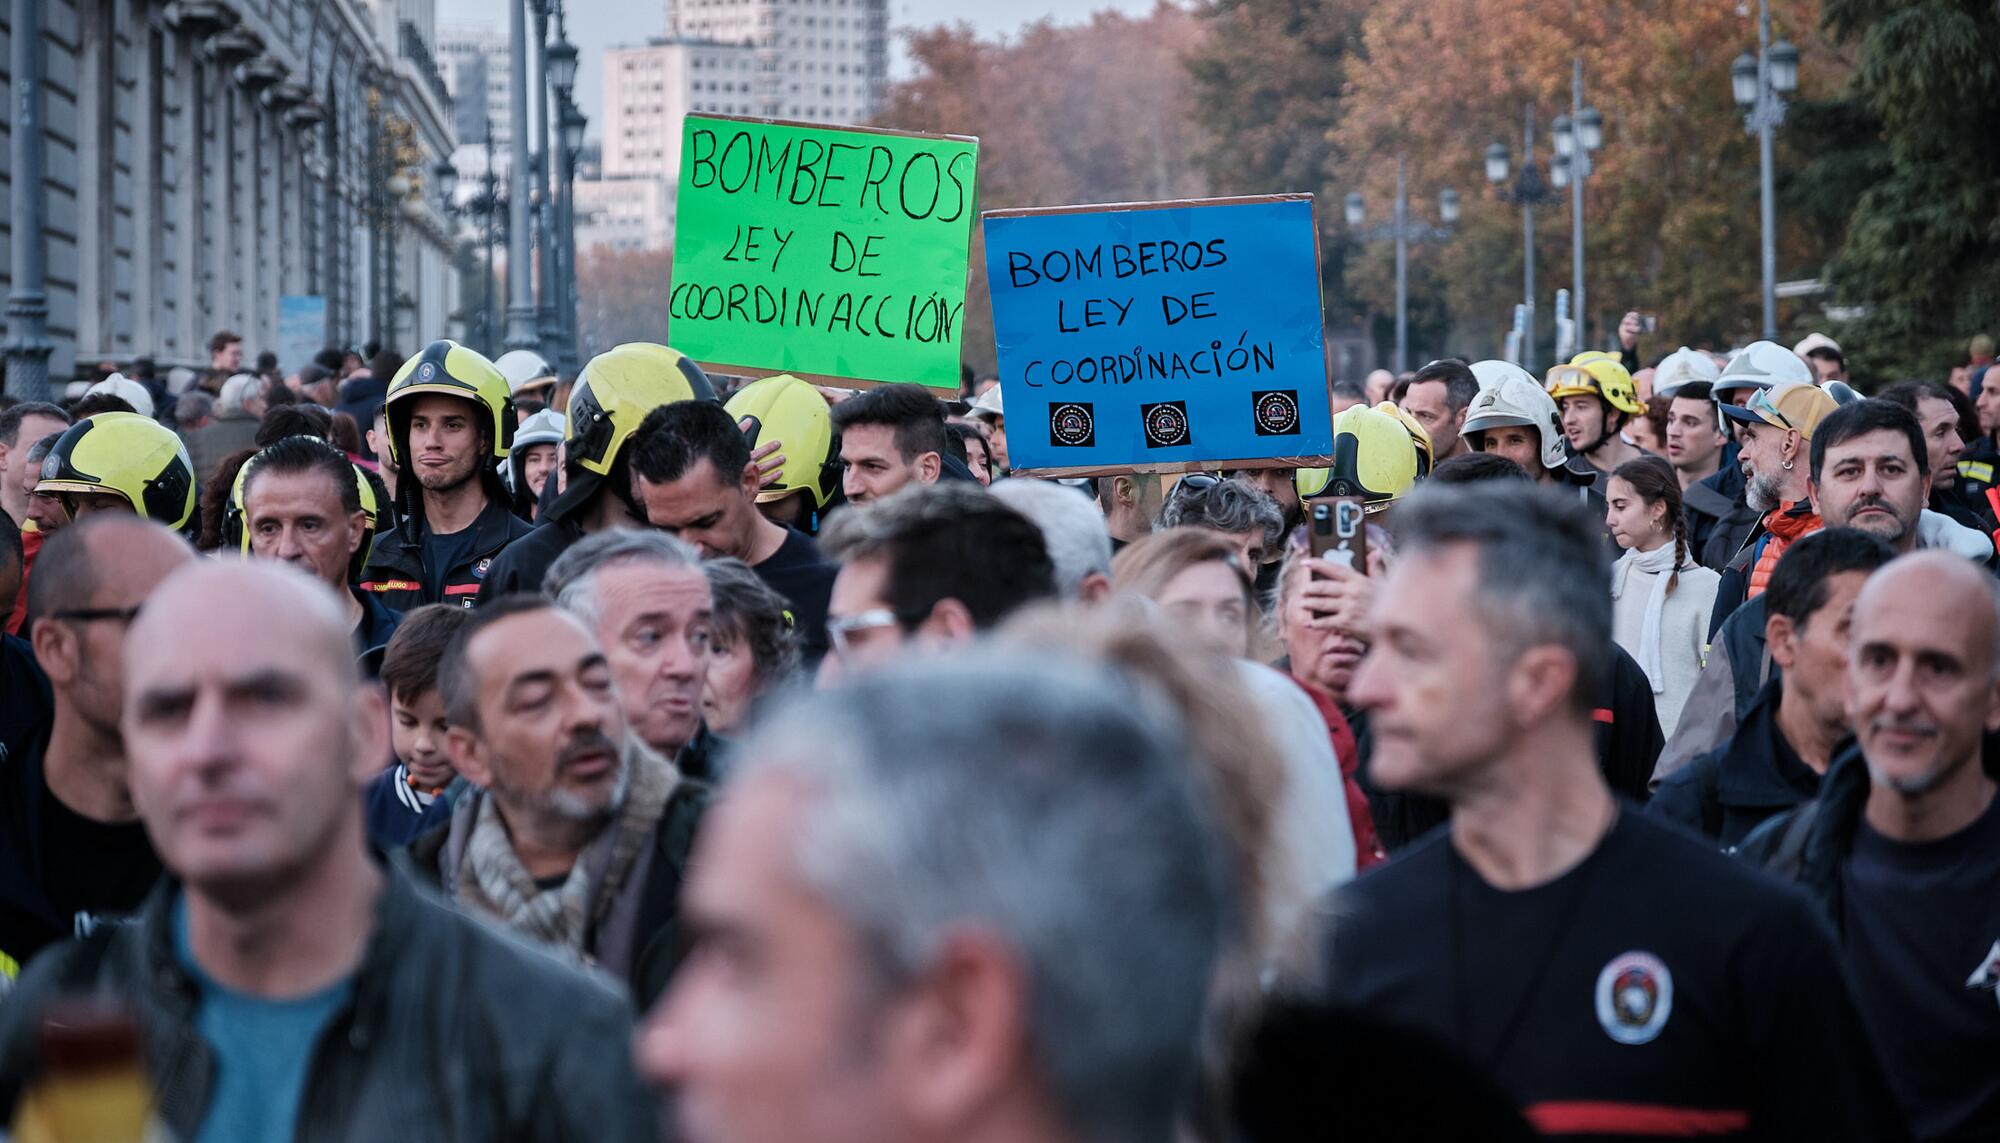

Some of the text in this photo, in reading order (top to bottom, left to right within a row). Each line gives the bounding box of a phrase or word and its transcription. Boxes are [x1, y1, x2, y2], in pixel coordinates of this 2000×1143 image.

[692, 130, 973, 222] BOMBEROS
[723, 225, 886, 276] LEY DE
[1008, 238, 1227, 288] BOMBEROS
[670, 284, 963, 343] COORDINACCIÓN
[1058, 292, 1217, 333] LEY DE
